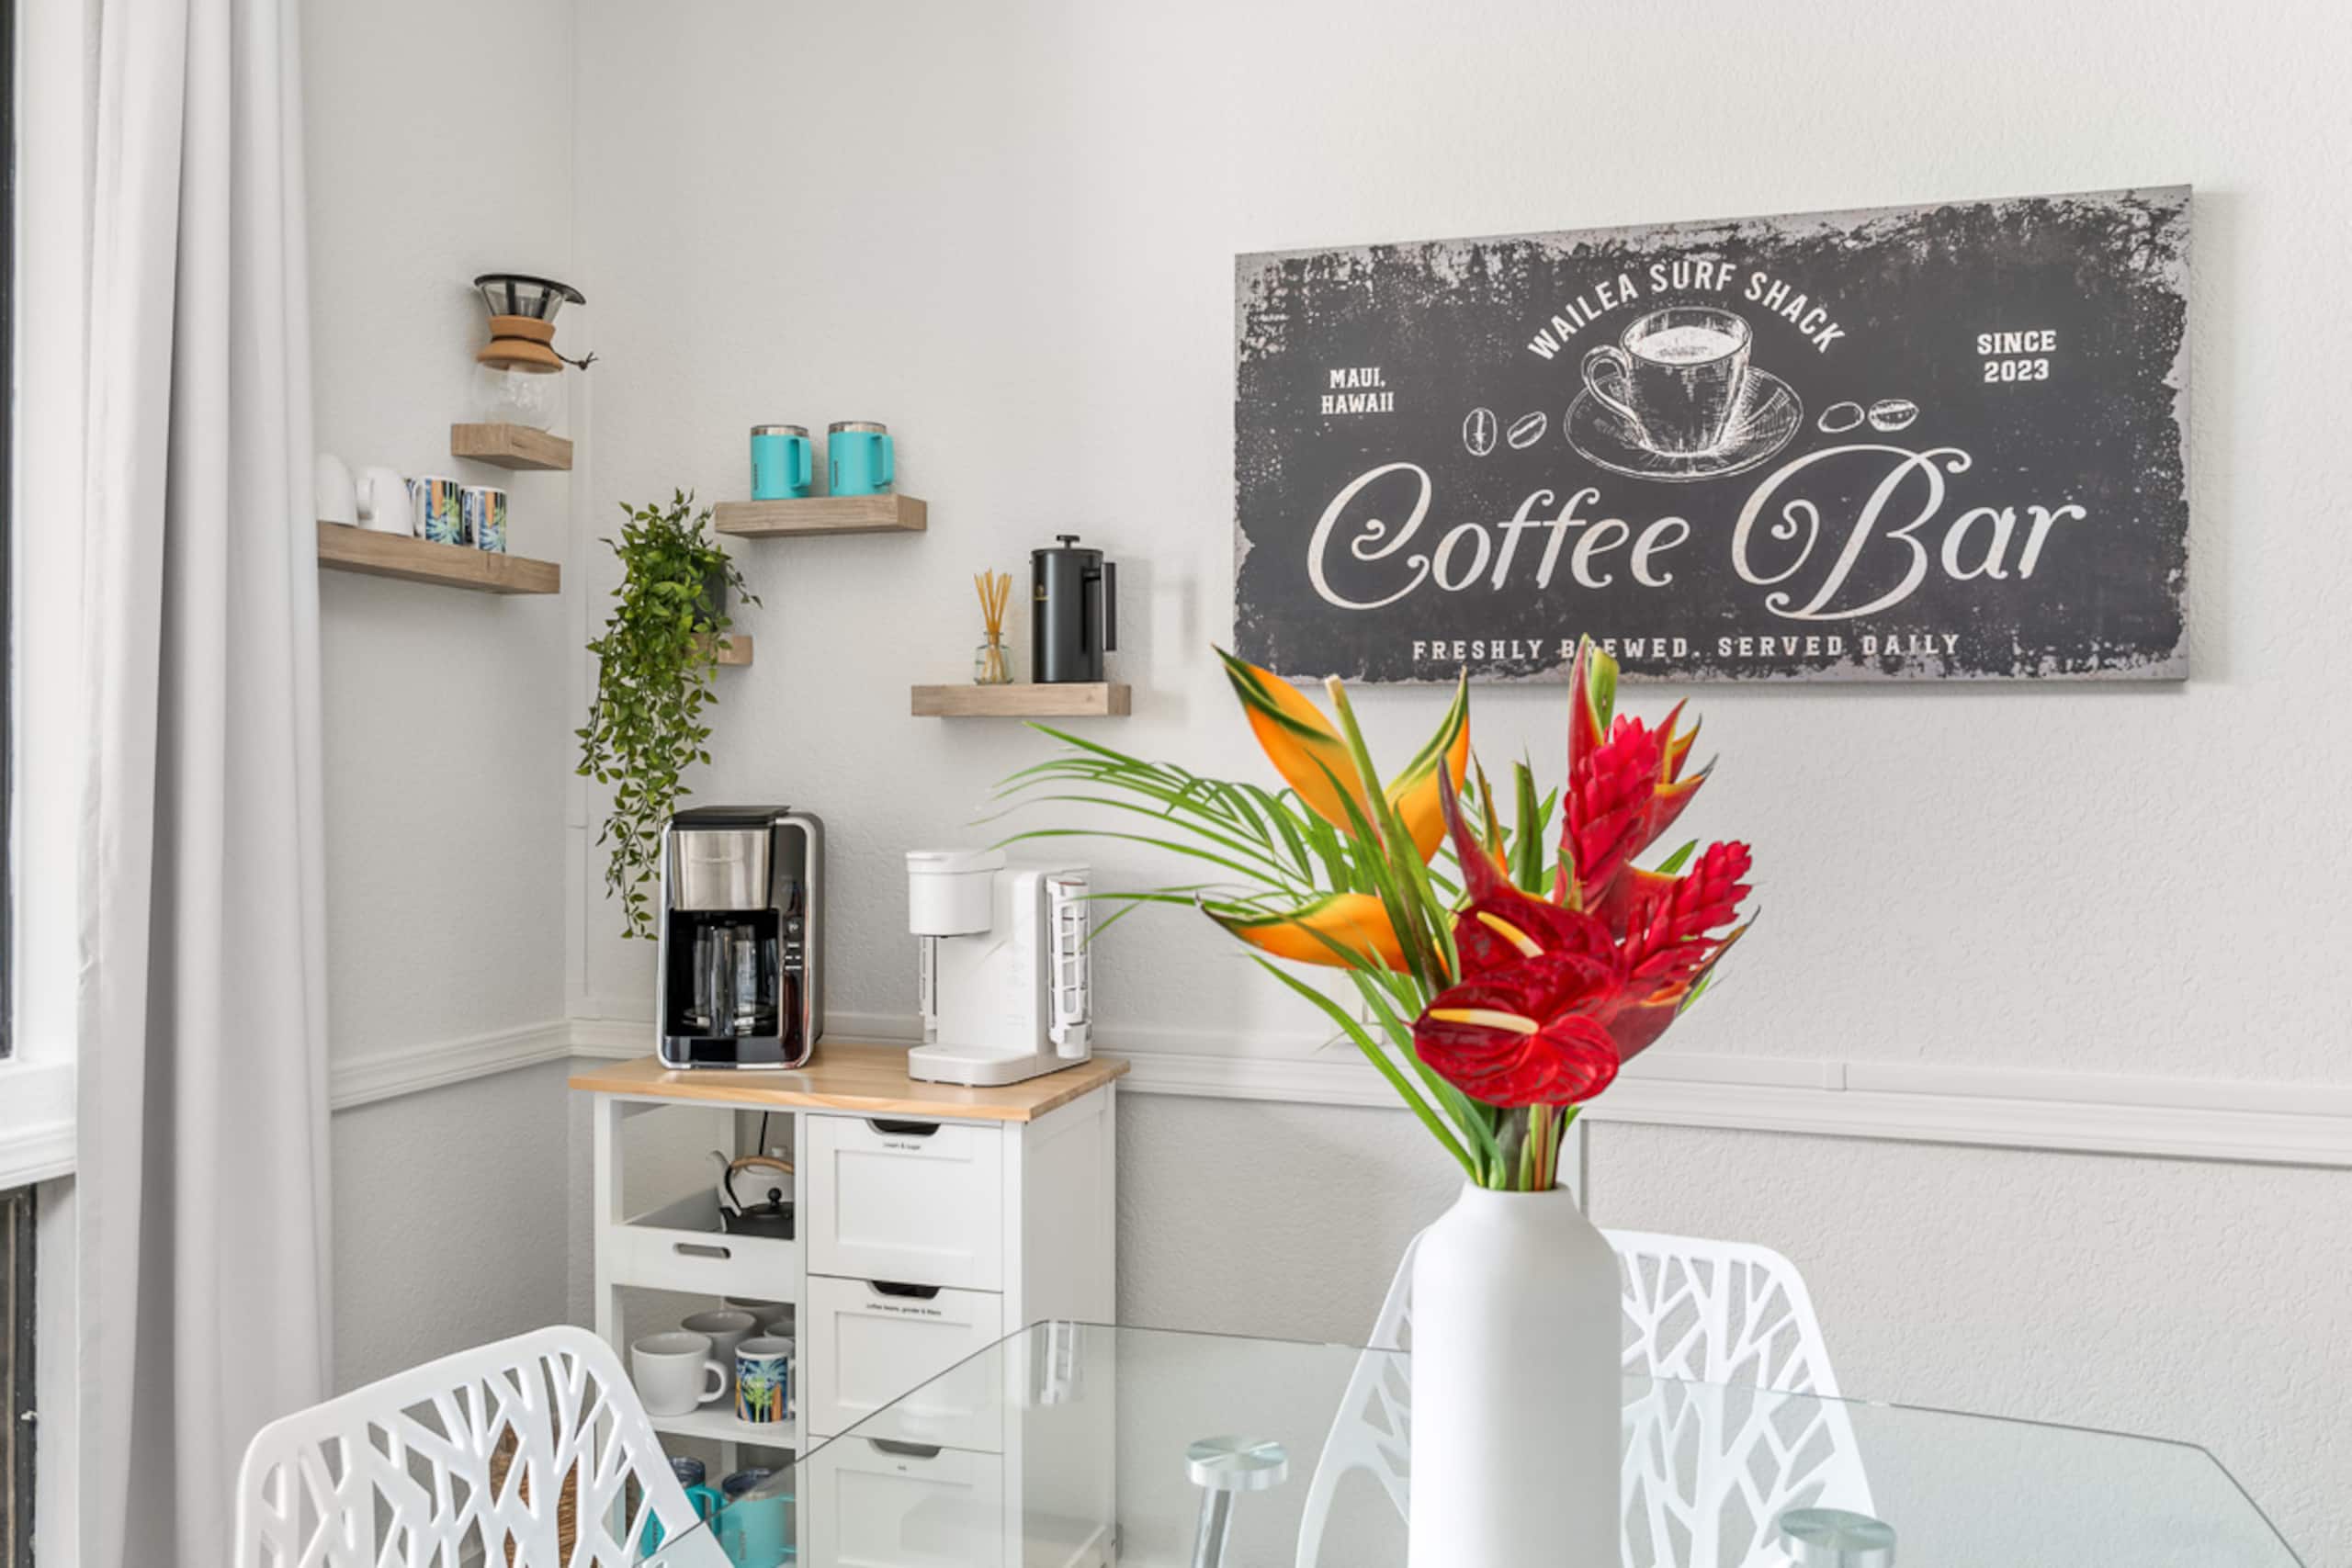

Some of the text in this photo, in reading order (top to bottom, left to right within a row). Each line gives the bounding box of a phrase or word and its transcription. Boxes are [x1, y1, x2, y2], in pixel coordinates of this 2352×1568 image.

[1528, 261, 1845, 359] WAILEA SURF SHACK
[1977, 330, 2056, 355] SINCE
[1984, 358, 2049, 382] 2023
[1321, 392, 1394, 413] HAWAII
[1307, 445, 2086, 621] Coffee Bar
[1413, 639, 1543, 660] FRESHLY
[1718, 637, 1842, 657] SERVED
[1862, 634, 1959, 656] DAILY
